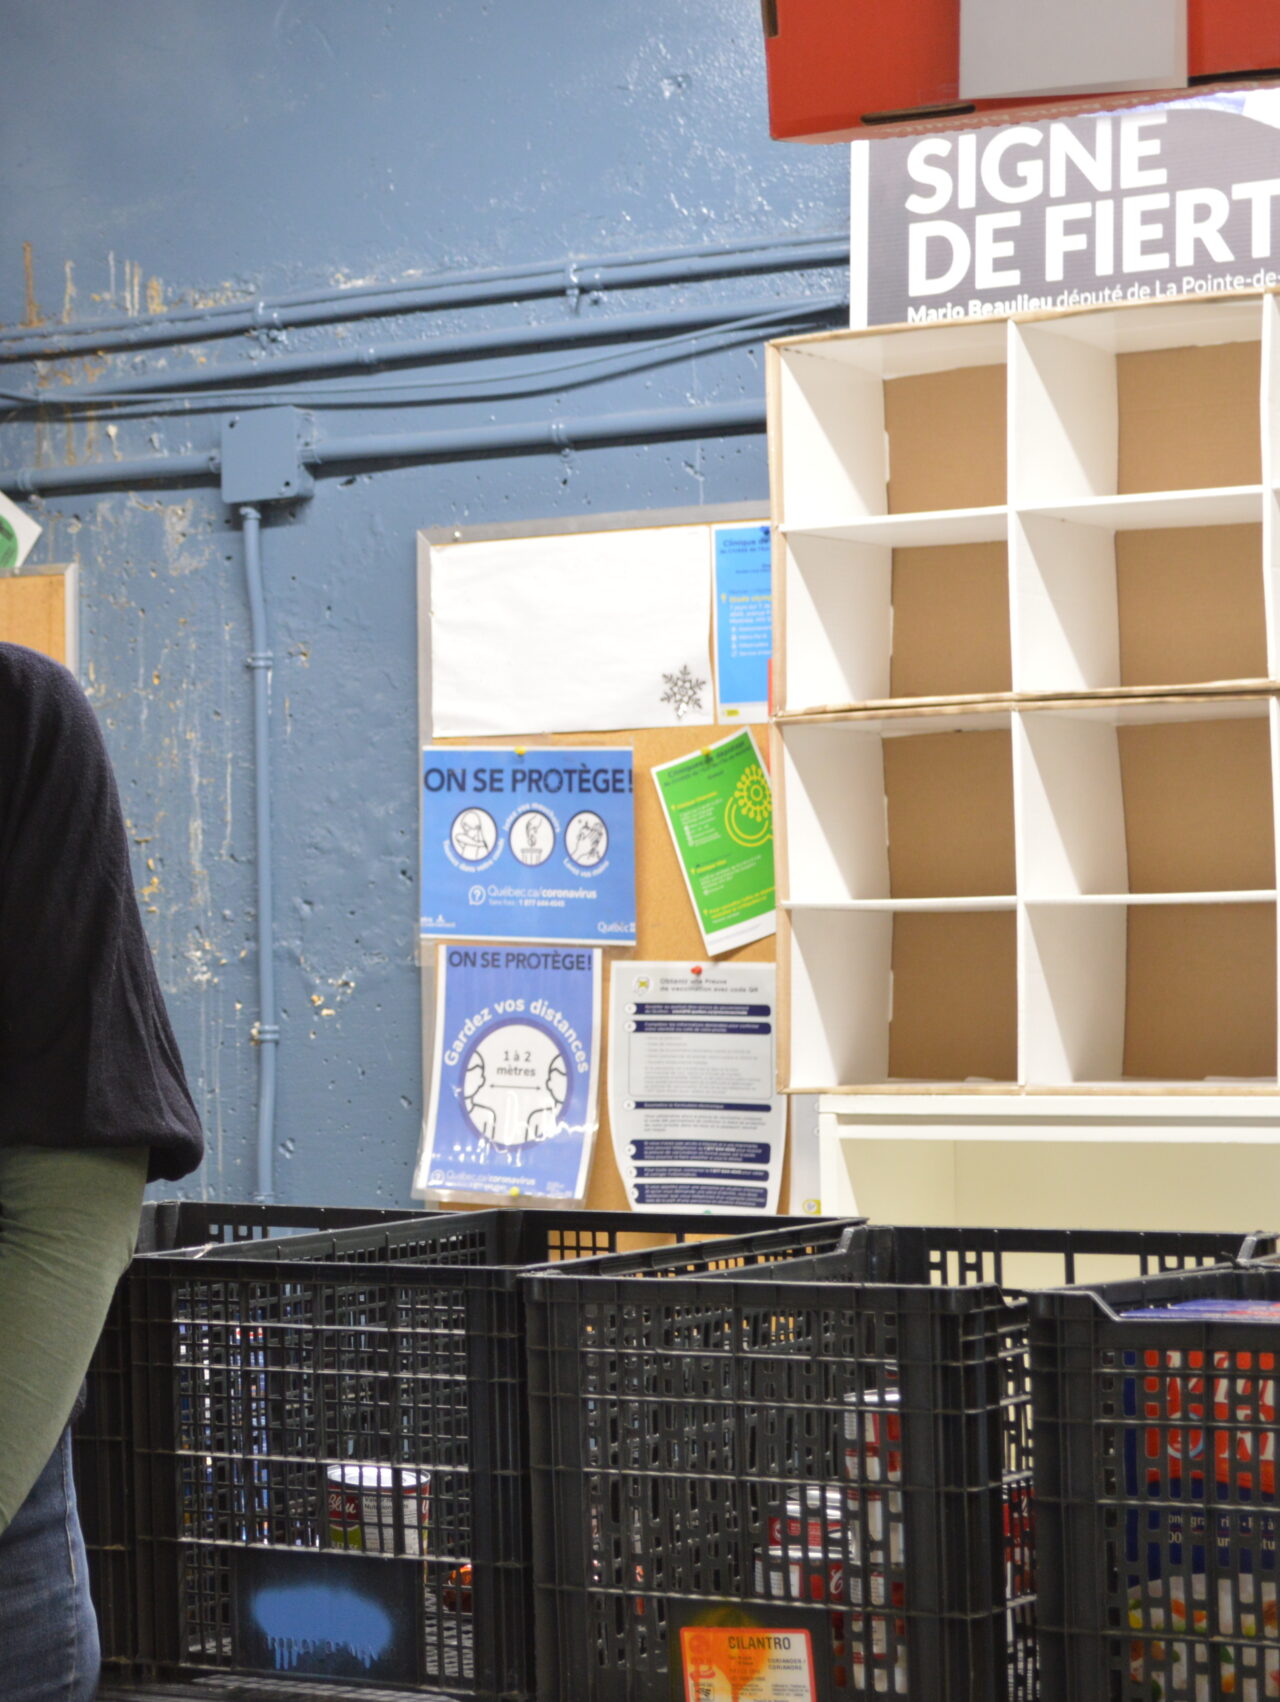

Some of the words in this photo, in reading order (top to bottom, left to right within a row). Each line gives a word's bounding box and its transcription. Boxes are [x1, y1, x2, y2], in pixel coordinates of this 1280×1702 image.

[905, 113, 1168, 215] SIGNE
[907, 211, 1022, 297] DE
[1045, 178, 1280, 281] FIERT
[907, 302, 965, 324] Mario
[969, 295, 1053, 317] Beaulieu
[1056, 285, 1123, 307] député
[1127, 282, 1151, 299] de
[1156, 280, 1178, 298] La
[423, 768, 466, 792] ON
[473, 768, 504, 792] SE
[511, 763, 634, 794] PROTÈGE!
[448, 951, 477, 968] ON
[480, 952, 501, 968] SE
[505, 950, 592, 971] PROTÈGE!
[444, 1007, 492, 1066] Gardez
[494, 999, 525, 1014] vos
[530, 999, 589, 1073] distances
[496, 1065, 536, 1077] mètres
[514, 1051, 520, 1061] à
[524, 1051, 531, 1062] 2
[727, 1636, 791, 1650] CILANTRO
